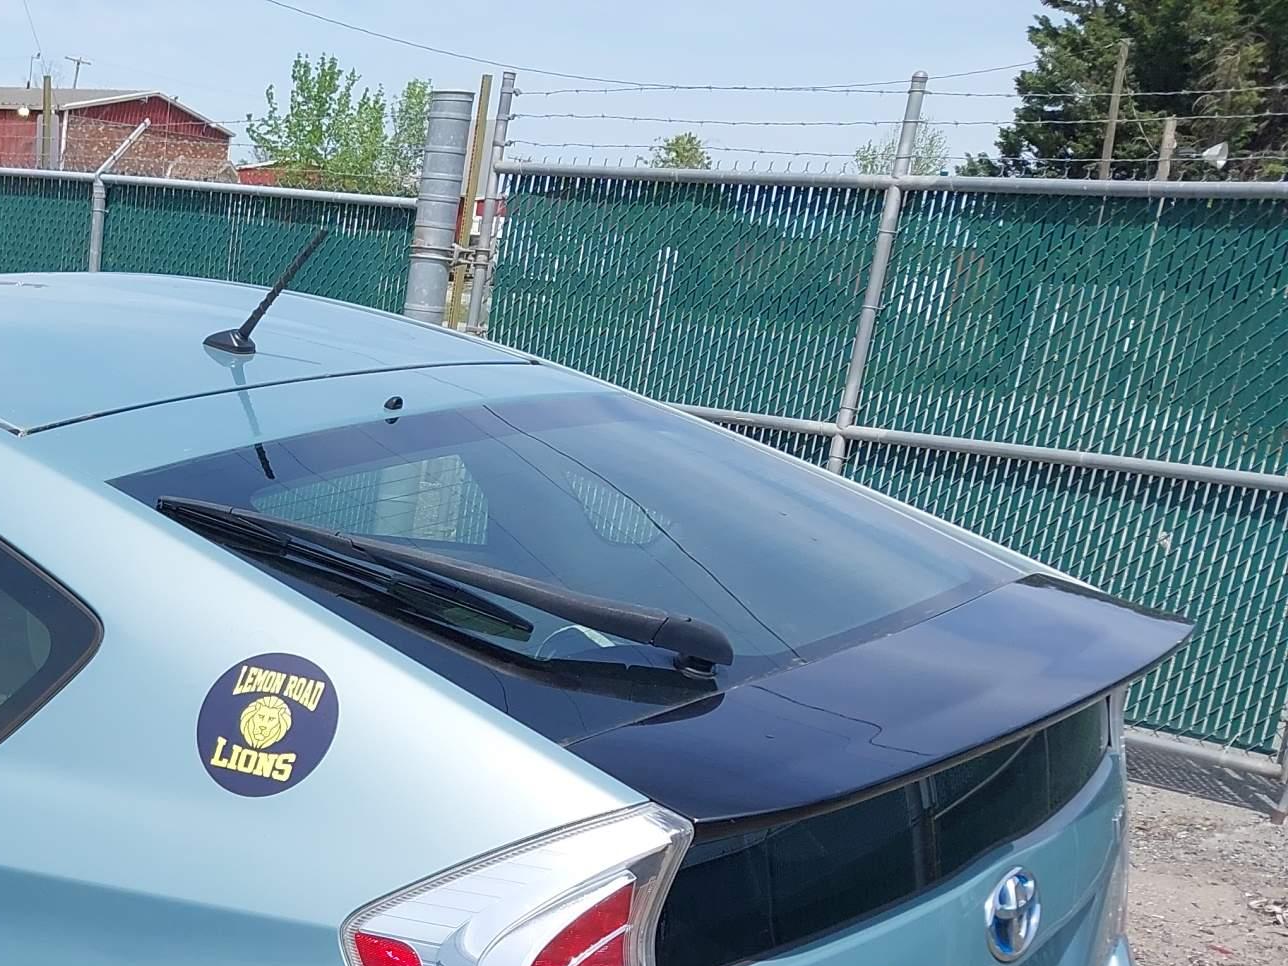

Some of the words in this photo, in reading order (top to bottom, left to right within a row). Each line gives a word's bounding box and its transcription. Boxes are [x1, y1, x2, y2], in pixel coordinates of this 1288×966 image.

[232, 665, 286, 695] LEMON
[283, 675, 325, 712] ROAD
[210, 736, 297, 782] LIONS
